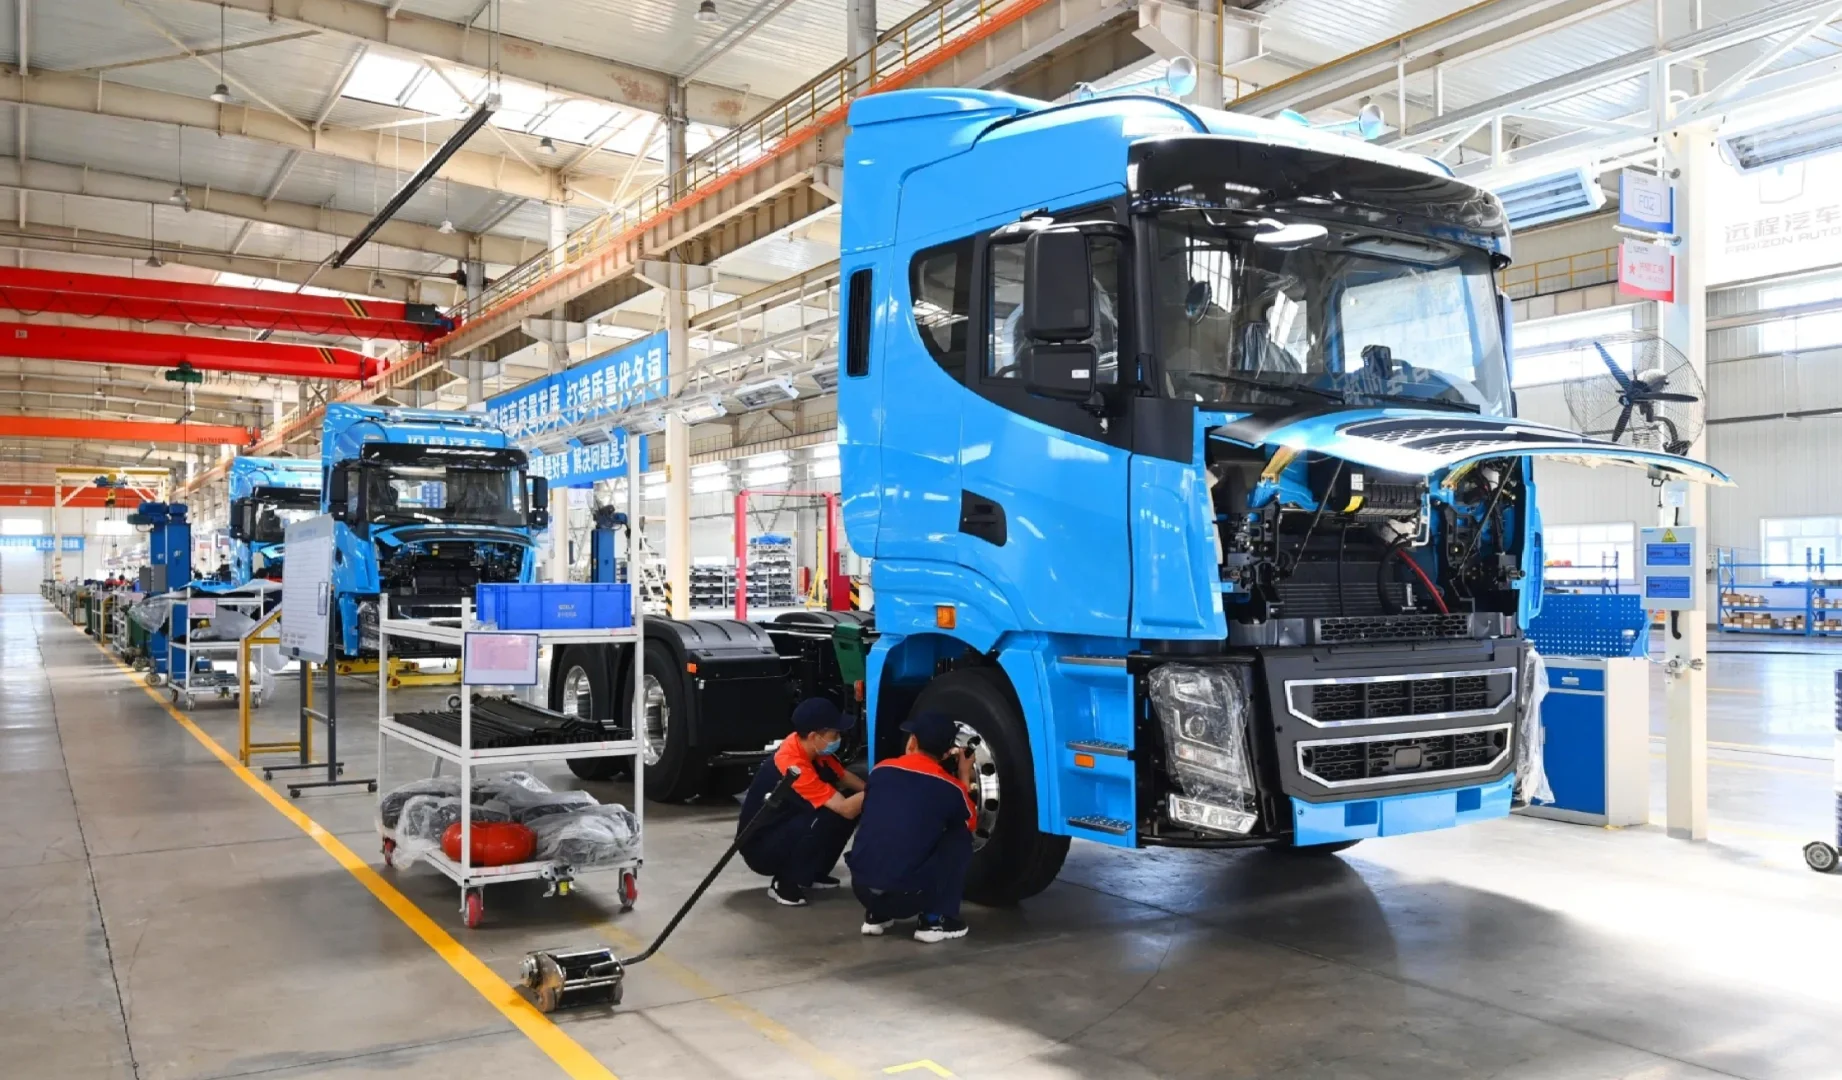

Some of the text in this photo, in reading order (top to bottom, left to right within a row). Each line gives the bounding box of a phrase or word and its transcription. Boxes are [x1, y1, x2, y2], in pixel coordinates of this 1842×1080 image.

[1724, 203, 1841, 243] 远程汽车
[1724, 225, 1842, 255] FARIZON AUTO
[566, 347, 662, 423] 打造质量代名词
[572, 435, 640, 474] 解决问题是大
